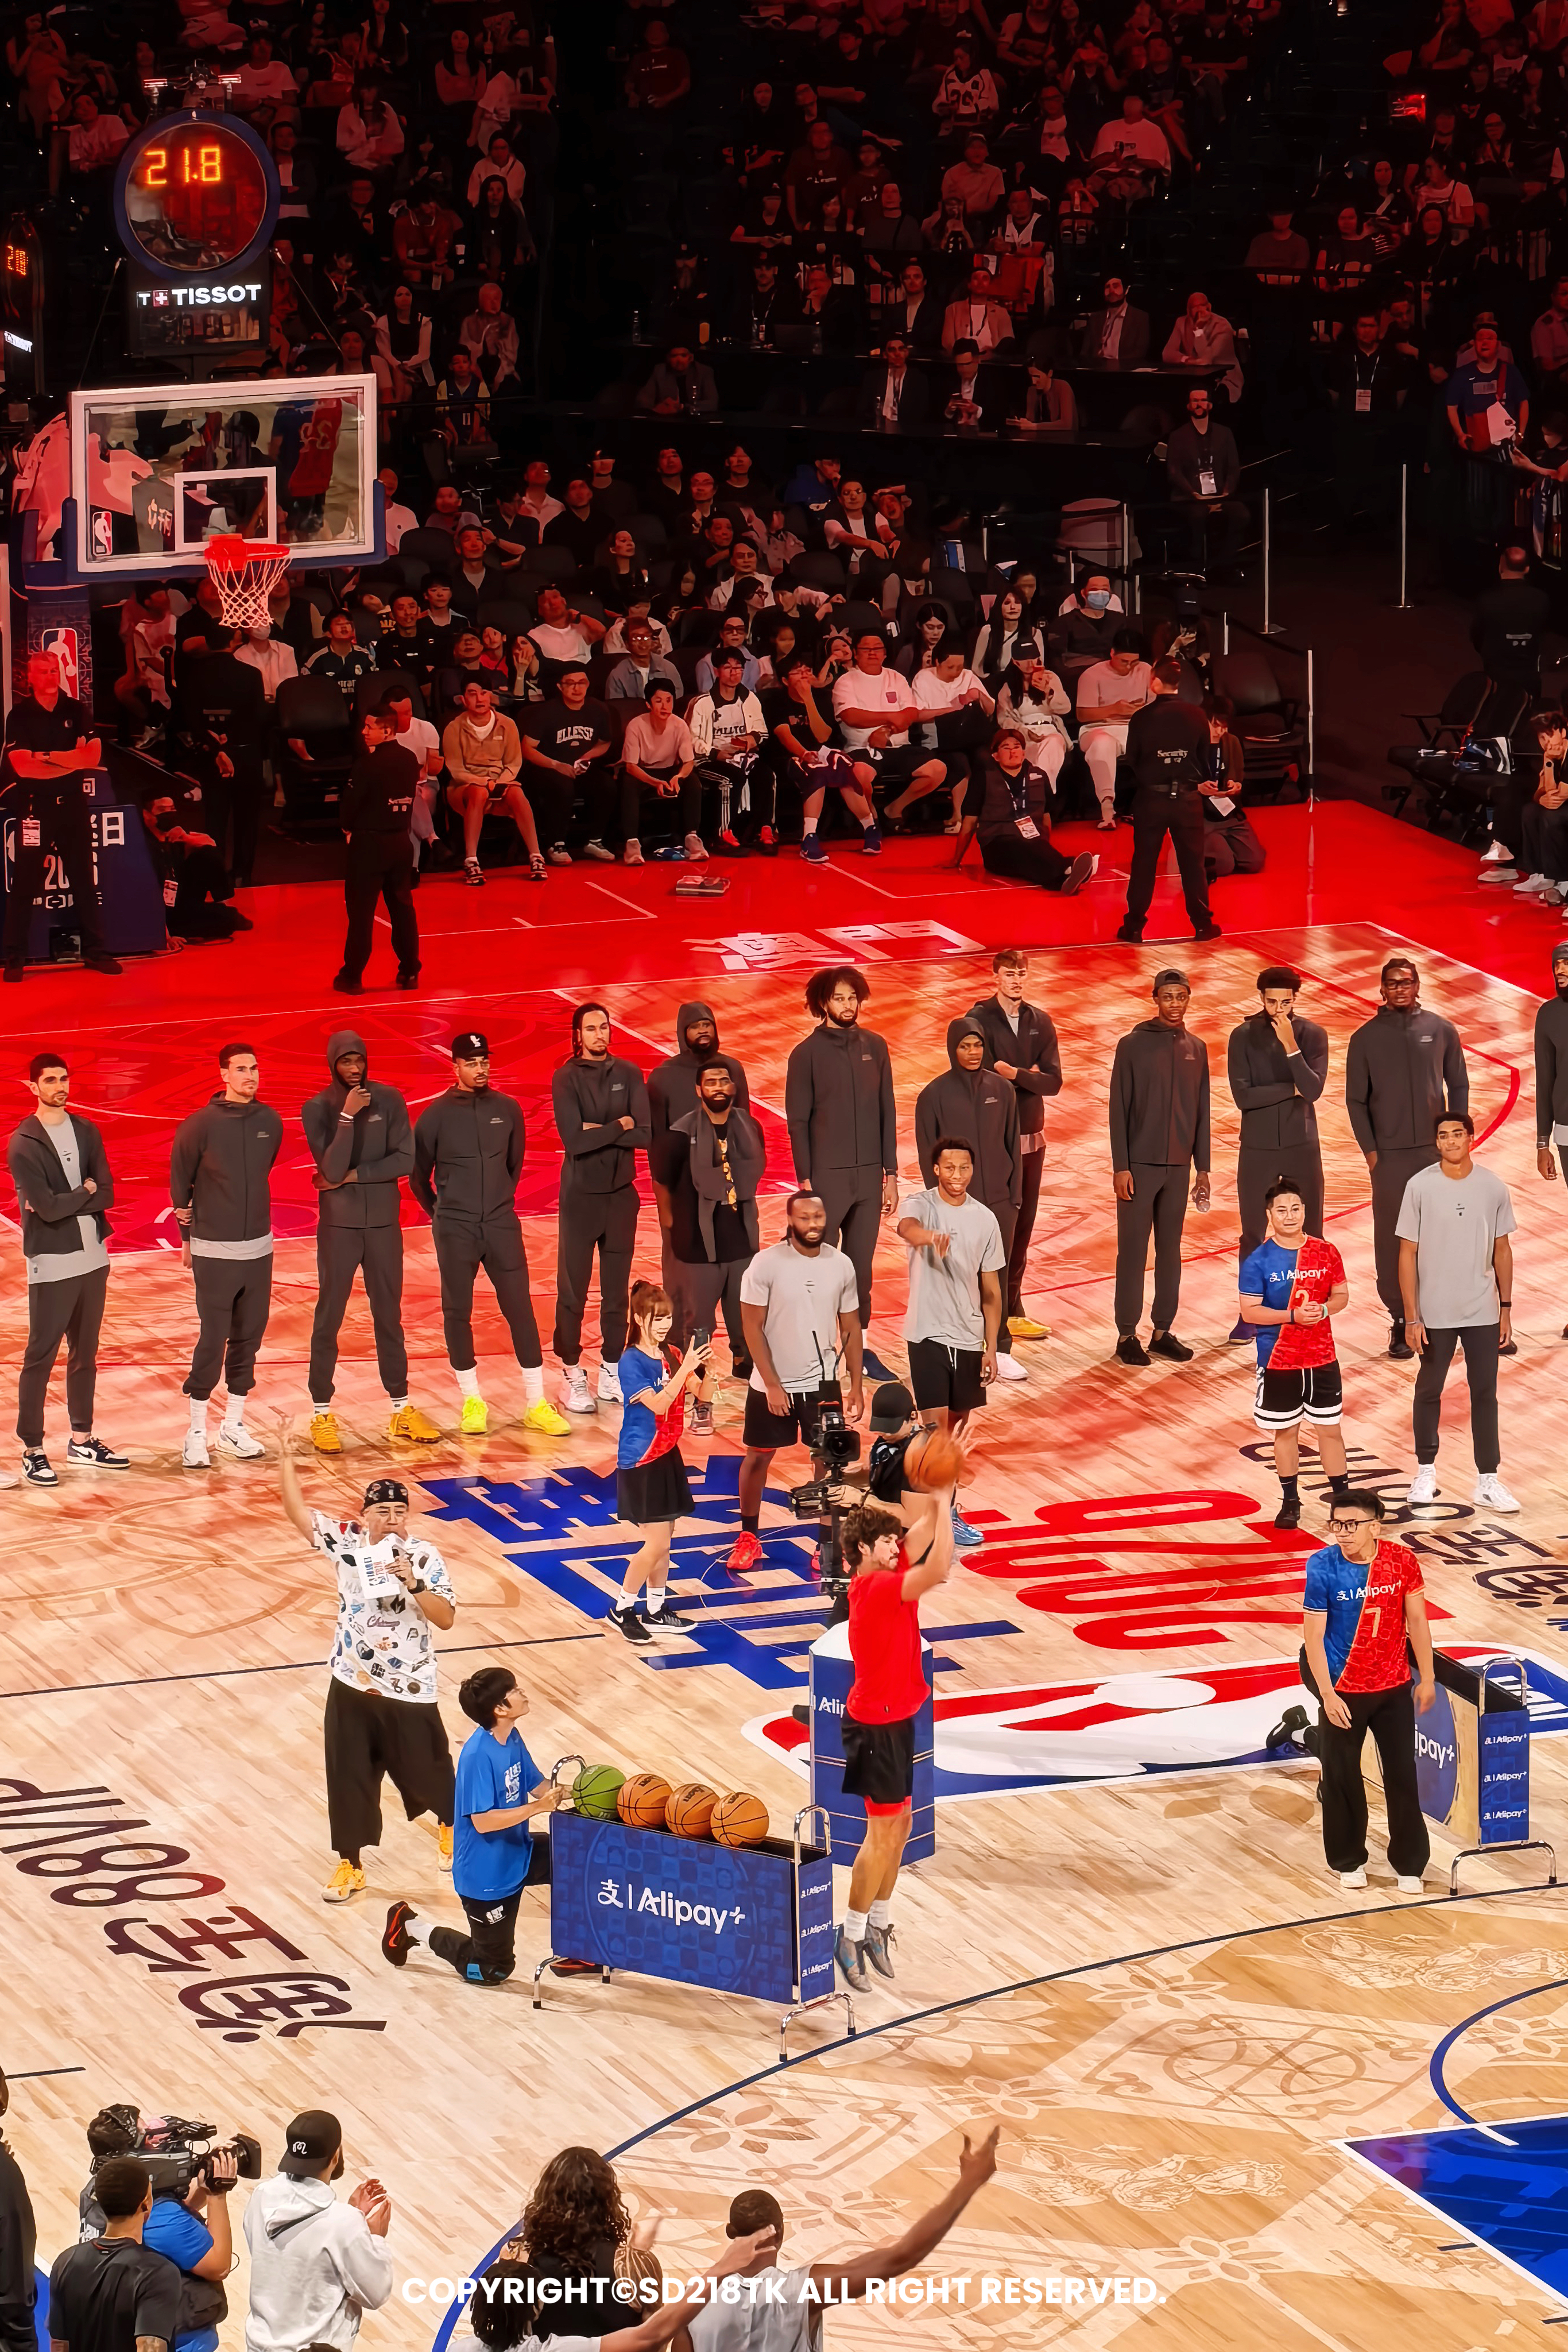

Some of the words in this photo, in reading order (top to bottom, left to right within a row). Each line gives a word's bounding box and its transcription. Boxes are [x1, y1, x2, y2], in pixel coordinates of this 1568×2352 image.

[145, 147, 221, 184] 21.8
[172, 284, 262, 305] TISSOT
[682, 920, 986, 970] 澳門
[1364, 1607, 1381, 1638] 7
